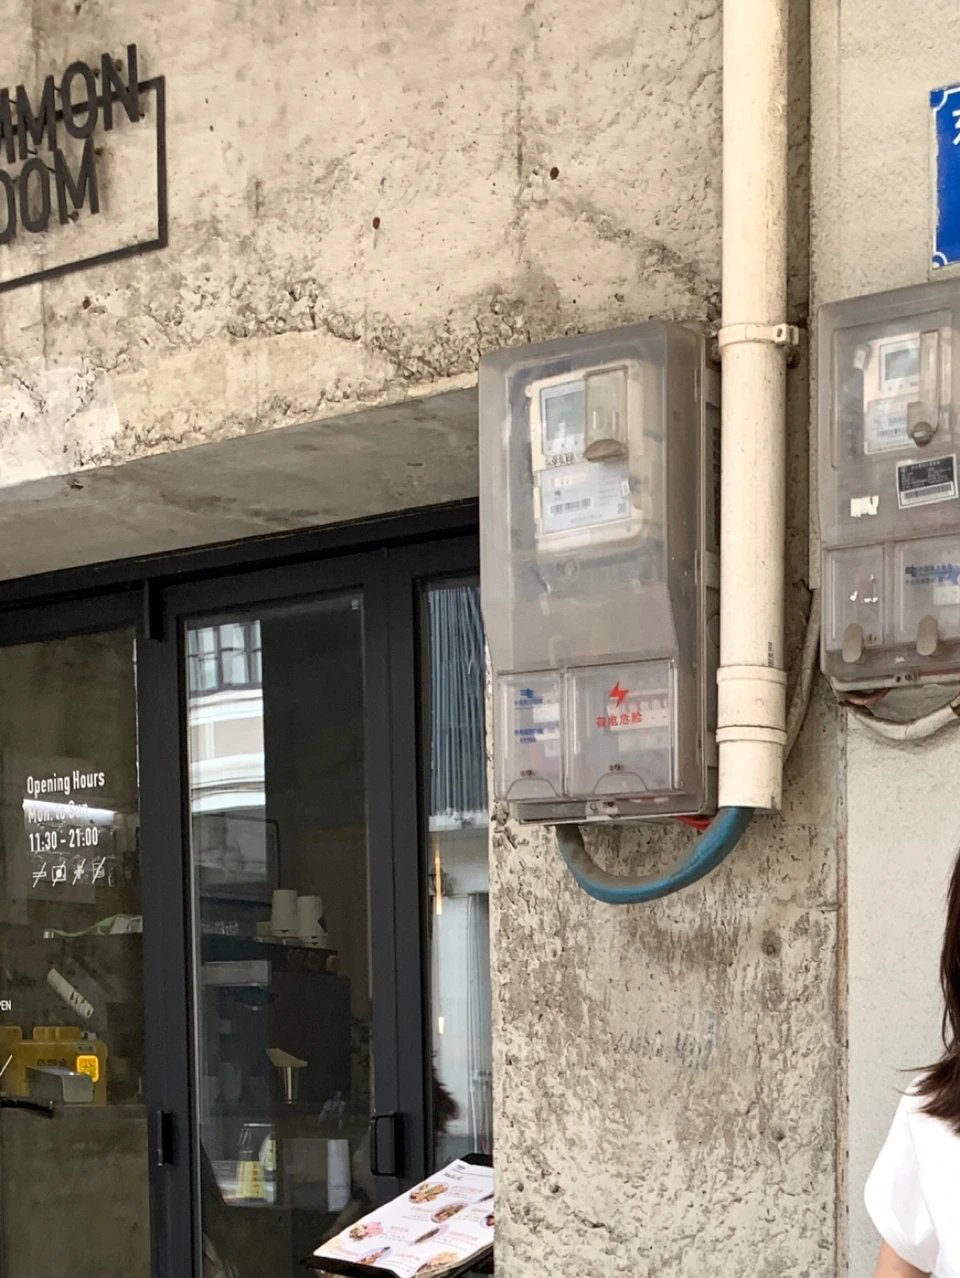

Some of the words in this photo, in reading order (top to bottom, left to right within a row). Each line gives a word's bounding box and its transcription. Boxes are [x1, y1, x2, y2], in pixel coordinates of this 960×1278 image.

[27, 773, 70, 799] Opening
[73, 770, 105, 790] Hours
[29, 831, 57, 852] 11:30
[69, 827, 98, 848] 21:00
[0, 1000, 12, 1010] EN
